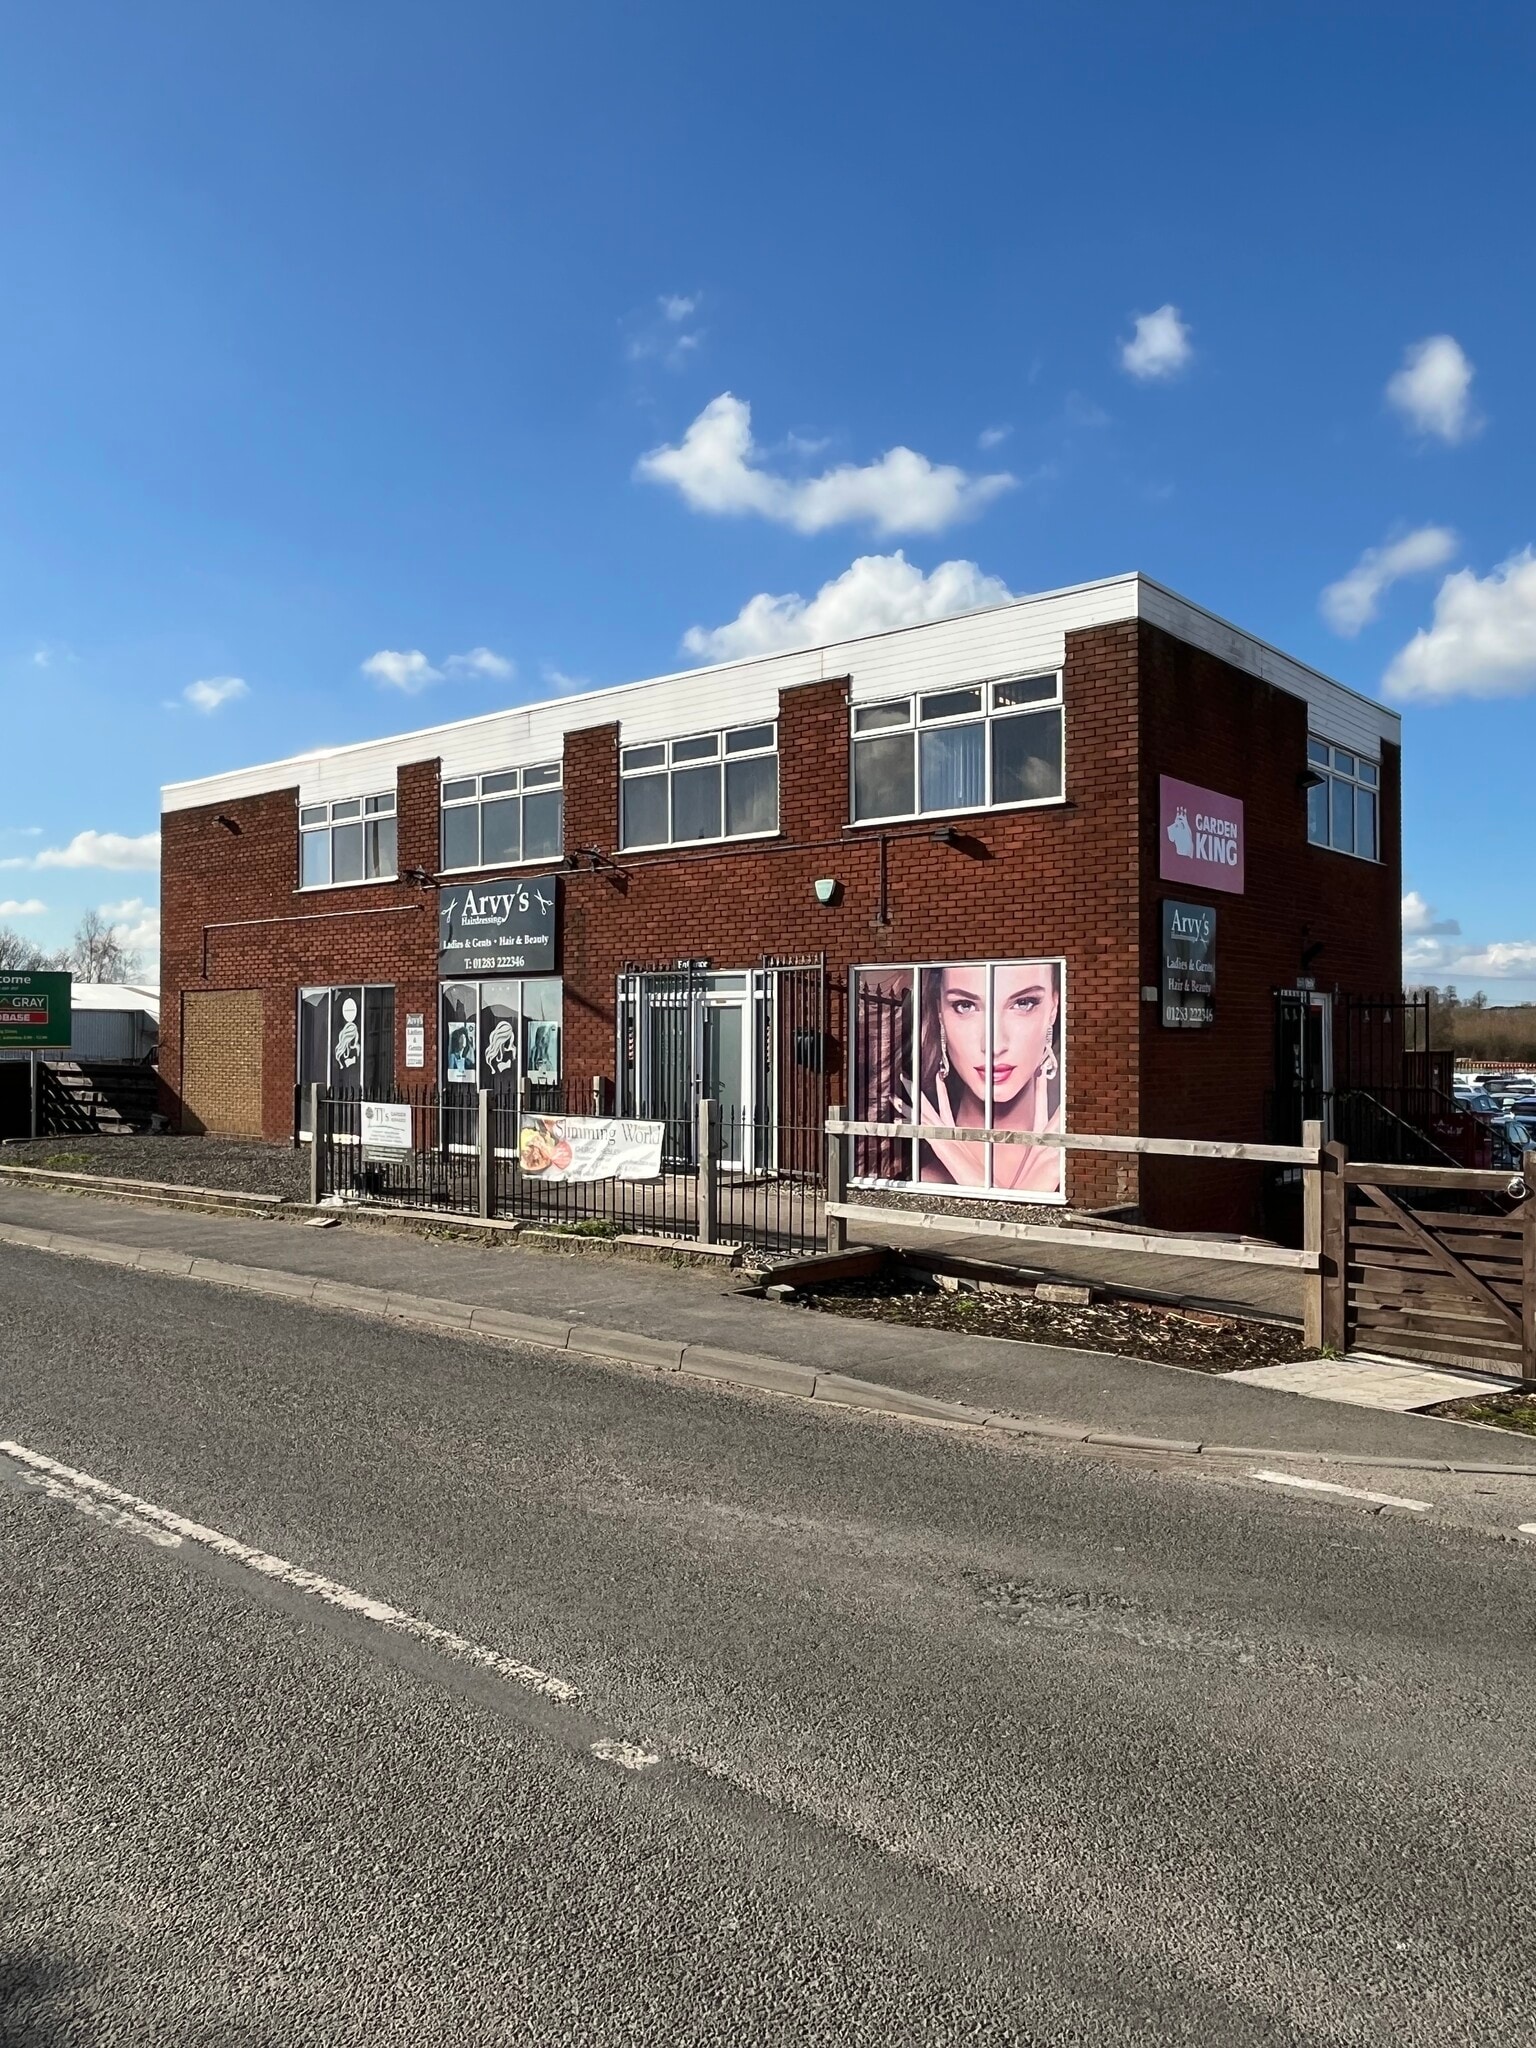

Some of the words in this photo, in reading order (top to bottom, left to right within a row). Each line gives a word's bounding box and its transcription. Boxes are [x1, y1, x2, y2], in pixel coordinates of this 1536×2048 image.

[1195, 814, 1238, 839] GARDEN
[1195, 832, 1238, 866] KING
[461, 883, 530, 923] Arvy's
[461, 914, 503, 926] Hairdressing
[1171, 909, 1210, 942] Arvy's
[443, 939, 464, 950] Ladies
[465, 939, 472, 948] &
[472, 938, 492, 948] Gents
[499, 936, 515, 946] Hair
[515, 936, 523, 945] &
[524, 935, 549, 946] Beauty
[464, 958, 473, 969] T:
[473, 957, 496, 968] 01283
[497, 956, 525, 968] 222346
[1166, 956, 1188, 970] Ladies
[1188, 959, 1195, 971] &
[1195, 959, 1213, 973] Gents
[1168, 978, 1184, 991] Hair
[1184, 979, 1190, 992] &
[1191, 980, 1212, 996] Beauty
[12, 997, 45, 1007] GRAY
[0, 1013, 31, 1021] BASE
[555, 1119, 617, 1145] Slimming
[622, 1123, 662, 1145] World
